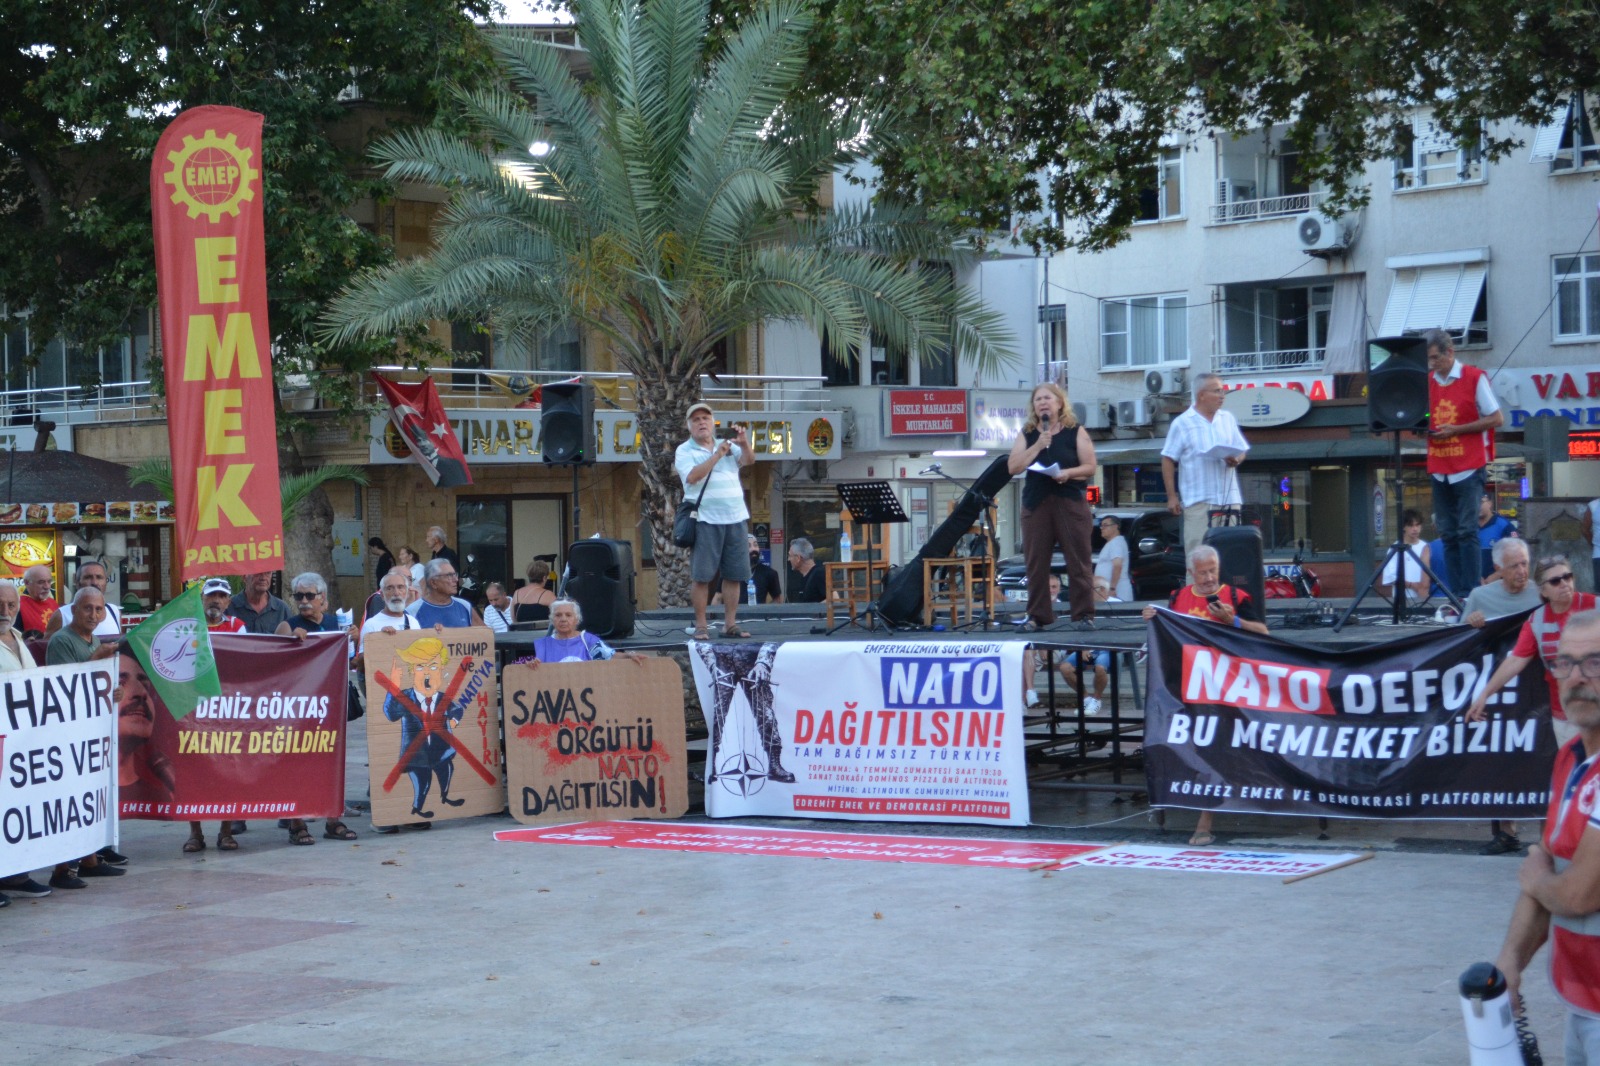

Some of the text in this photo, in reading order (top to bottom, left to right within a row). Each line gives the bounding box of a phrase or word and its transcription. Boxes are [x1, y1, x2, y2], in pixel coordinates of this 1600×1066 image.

[186, 165, 239, 187] EMEP
[182, 236, 263, 531] EMEK
[893, 401, 964, 416] İSKELE MAHALLESİ
[906, 417, 953, 431] MUHTARLIĞI
[0, 533, 27, 542] PATSO
[184, 535, 281, 567] PARTİSİ
[447, 642, 488, 657] TRUMP
[864, 643, 938, 654] EMPERYALİZMİN
[942, 644, 960, 656] SUÇ
[156, 662, 176, 677] PARTİ
[460, 661, 475, 673] ve
[888, 660, 998, 706] NATO
[1187, 649, 1321, 712] NATO
[5, 670, 113, 730] HAYIR
[195, 691, 329, 724] DENİZ GÖKTAŞ
[511, 687, 597, 726] SAVAŞ
[793, 701, 1005, 748] DAĞITILSIN!
[178, 725, 337, 754] YALNIZ DEĞİLDİR!
[557, 717, 653, 755] ÖRGÜTÜ
[1167, 712, 1537, 760] BU MEMLEKET BİZİM
[9, 735, 111, 789] SES VER
[794, 746, 1001, 762] TAM BAĞIMSIZ TÜRKİYE
[598, 754, 659, 780] NATO
[808, 764, 851, 773] TOPLANMA:
[864, 766, 899, 774] TEMMUZ
[903, 766, 951, 775] CUMARTESİ
[836, 774, 864, 782] SOKAĞI
[913, 775, 937, 783] PİZZA
[964, 778, 1008, 786] ALTINOLUK
[828, 785, 1009, 798] MİTİNG: ALTINOLUK CUMHURİYET MEYDANI
[1170, 780, 1233, 798] KÖRFEZ
[1240, 786, 1284, 800] EMEK
[1292, 788, 1311, 801] VE
[1318, 792, 1411, 807] DEMOKRASİ
[3, 786, 107, 845] OLMASIN
[122, 802, 296, 815] EMEK VE DEMOKRASİ PLATFORMU
[795, 798, 1008, 815] EDREMİT EMEK VE DEMOKRASİ PLATFORMU
[789, 846, 955, 859] BAŞKANLIĞI
[887, 843, 990, 852] PARTİSİ
